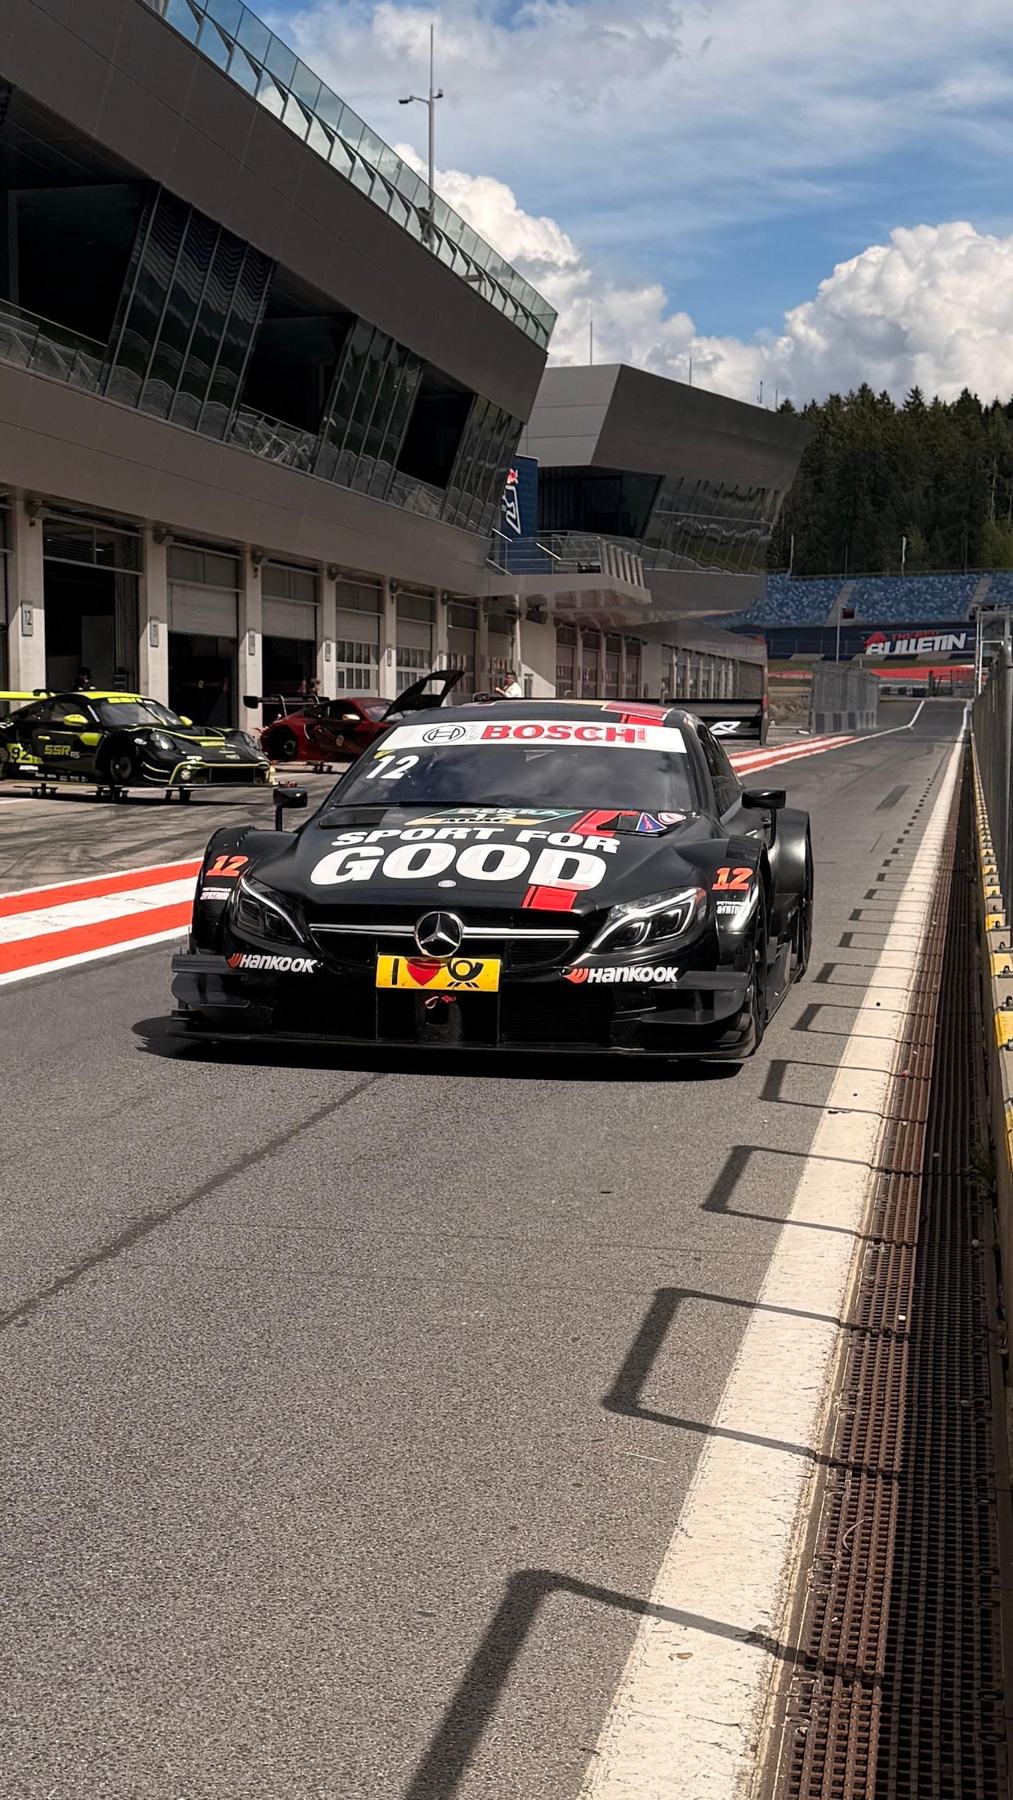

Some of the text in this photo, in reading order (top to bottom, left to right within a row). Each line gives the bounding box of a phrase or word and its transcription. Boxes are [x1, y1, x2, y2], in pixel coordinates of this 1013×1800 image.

[866, 633, 966, 655] BULLETIN
[480, 724, 636, 744] BOSCH
[44, 745, 70, 756] SSR
[365, 755, 419, 780] 12
[331, 827, 621, 854] SPORT FOR
[206, 855, 249, 877] 12
[310, 842, 607, 891] GOOD
[712, 867, 753, 890] 12
